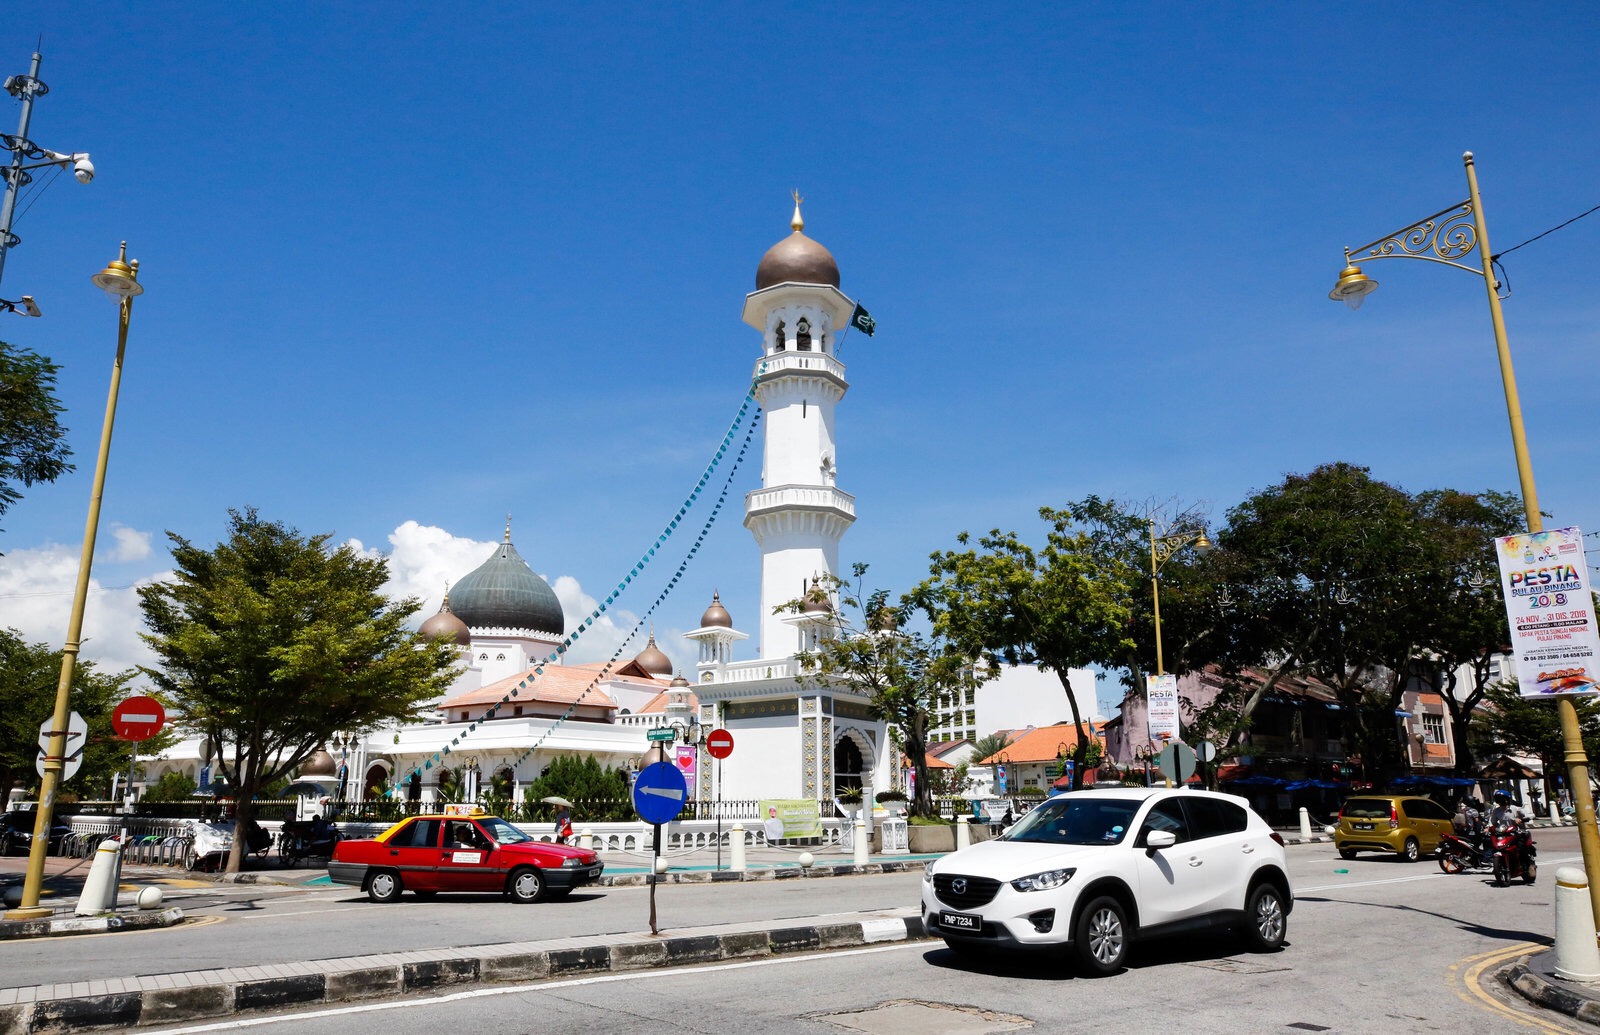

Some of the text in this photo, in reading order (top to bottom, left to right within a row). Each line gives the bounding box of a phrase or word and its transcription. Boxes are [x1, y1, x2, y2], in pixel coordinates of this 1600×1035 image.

[1508, 564, 1579, 588] PESTA
[1512, 581, 1581, 597] PULAU PINANG
[1529, 593, 1567, 609] 2018
[1516, 616, 1524, 624] 24
[1526, 615, 1541, 623] NOV.
[1547, 613, 1554, 621] 31
[1556, 611, 1568, 620] DIS.
[1570, 610, 1586, 619] 2018
[1519, 630, 1534, 638] TAPAK
[1550, 627, 1568, 635] SUNGAI
[956, 916, 973, 926] 7234
